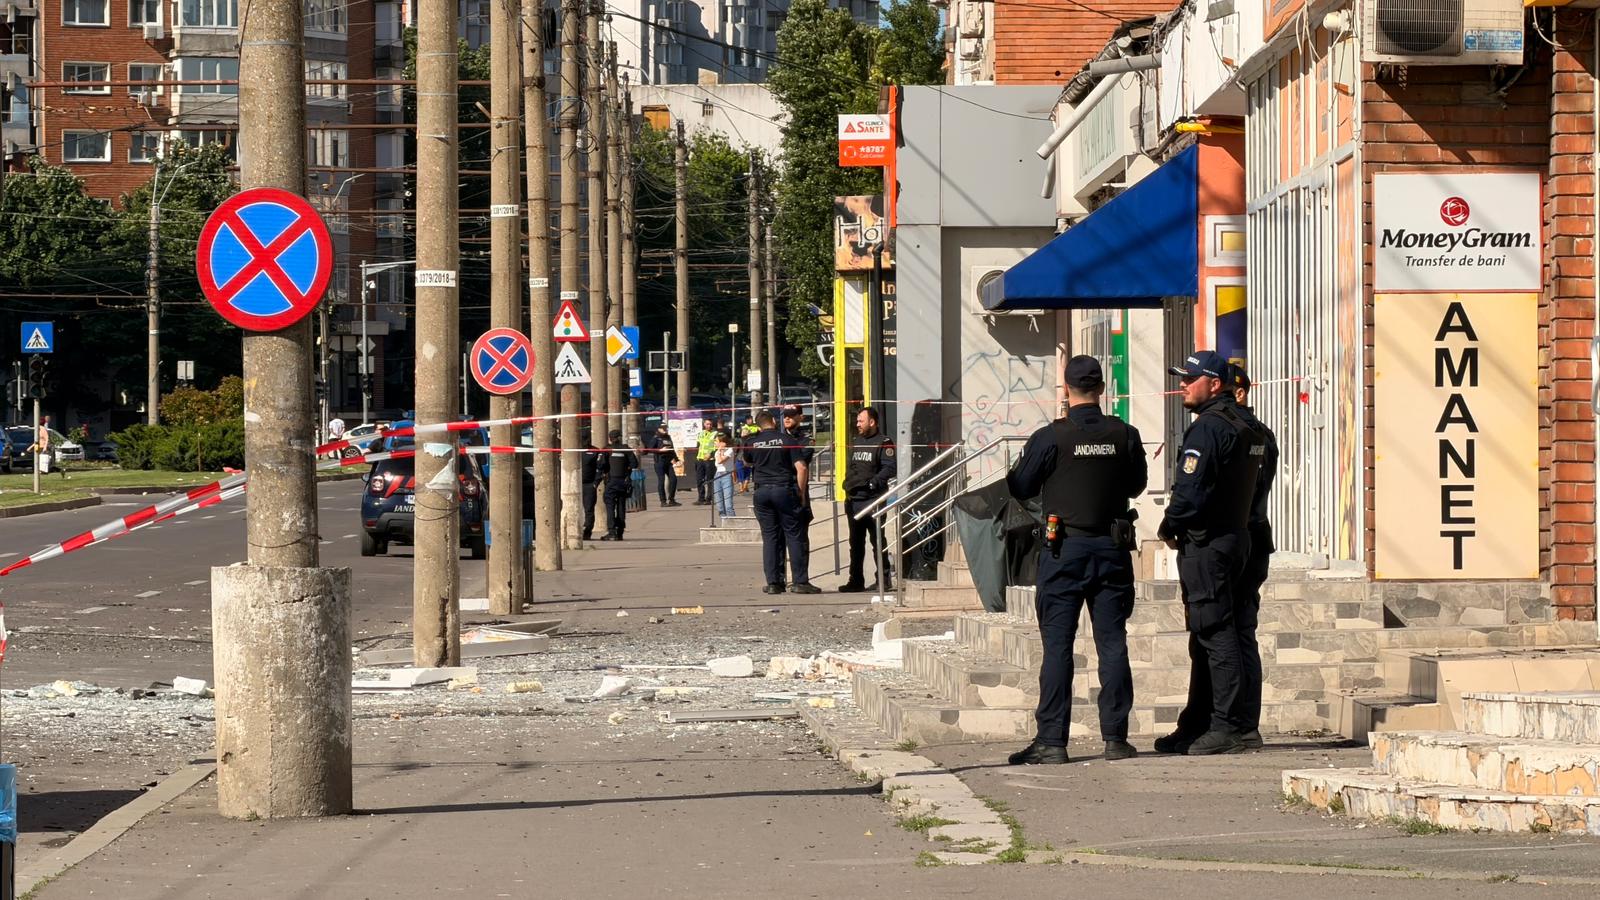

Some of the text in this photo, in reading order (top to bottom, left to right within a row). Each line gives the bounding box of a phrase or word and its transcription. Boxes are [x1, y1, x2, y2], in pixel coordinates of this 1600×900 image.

[857, 121, 885, 133] SANTE
[1405, 255, 1507, 267] Transfer de bani
[1434, 301, 1479, 570] AMANET
[1073, 443, 1117, 456] JANDARMERIA
